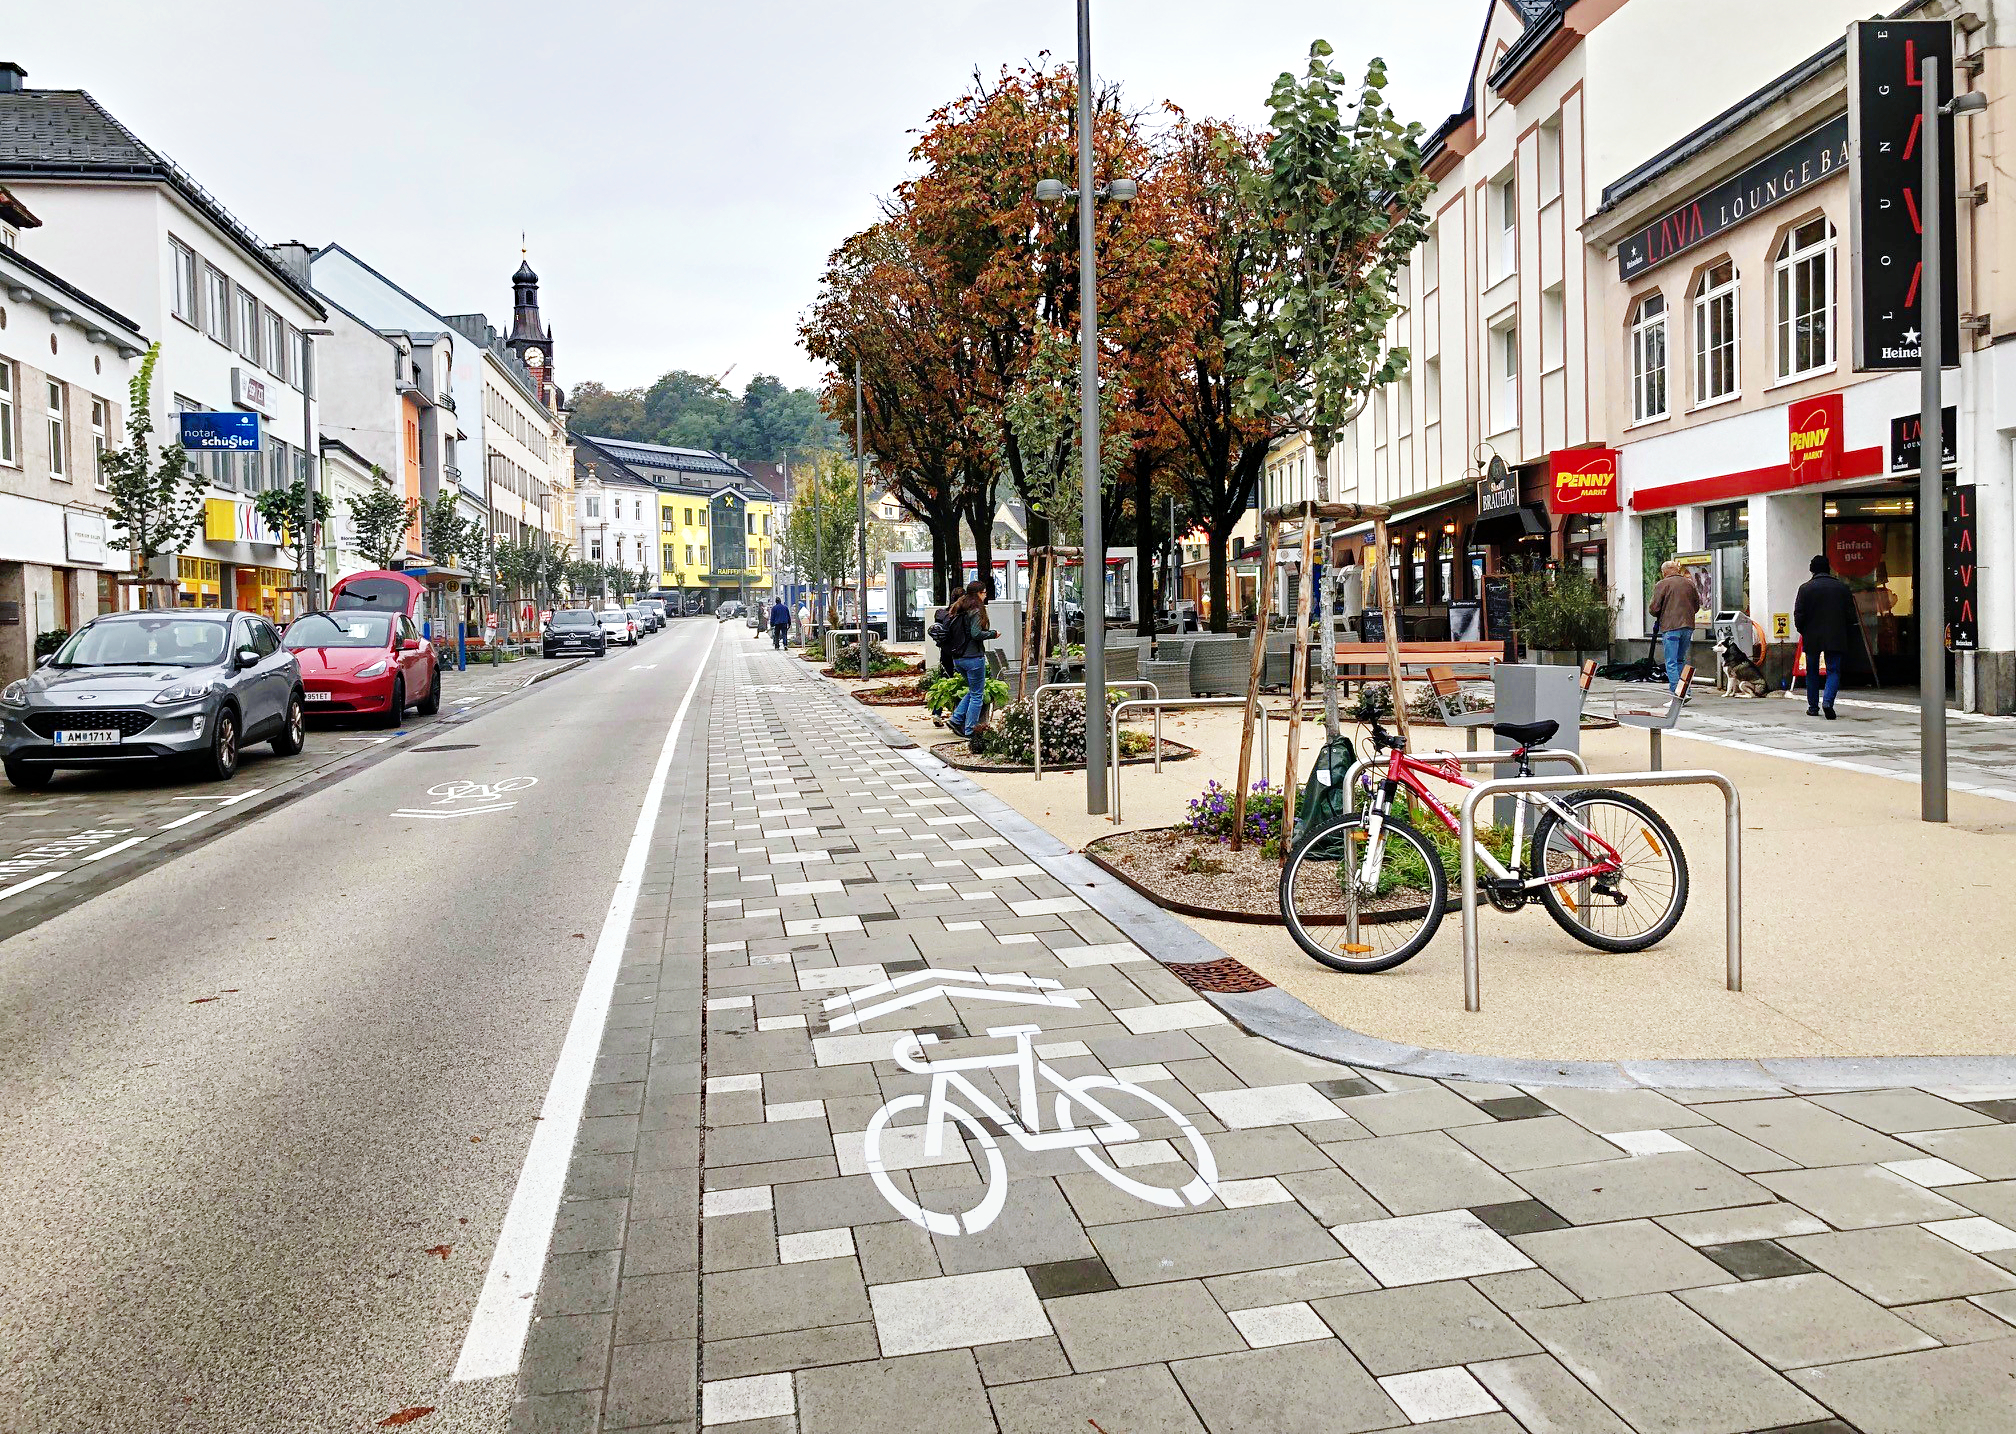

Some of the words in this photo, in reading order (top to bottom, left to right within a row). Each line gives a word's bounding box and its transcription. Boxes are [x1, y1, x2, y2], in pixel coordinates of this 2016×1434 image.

[1878, 29, 1893, 321] LOUNGE
[1647, 201, 1704, 263] LAVA
[1720, 160, 1811, 227] LOUNGE
[1820, 140, 1850, 174] BA
[1882, 347, 1922, 359] Heine
[184, 429, 215, 438] notar
[1790, 427, 1830, 453] PENNY
[1803, 450, 1824, 461] MARKT
[1555, 472, 1615, 488] PENNY
[1482, 487, 1516, 512] BRAUHOF
[1580, 488, 1608, 496] MARKT
[1836, 541, 1873, 550] Einfach
[1960, 494, 1973, 623] LAVA
[67, 733, 82, 742] AM
[88, 731, 113, 742] 171X
[1425, 791, 1460, 829] GENES
